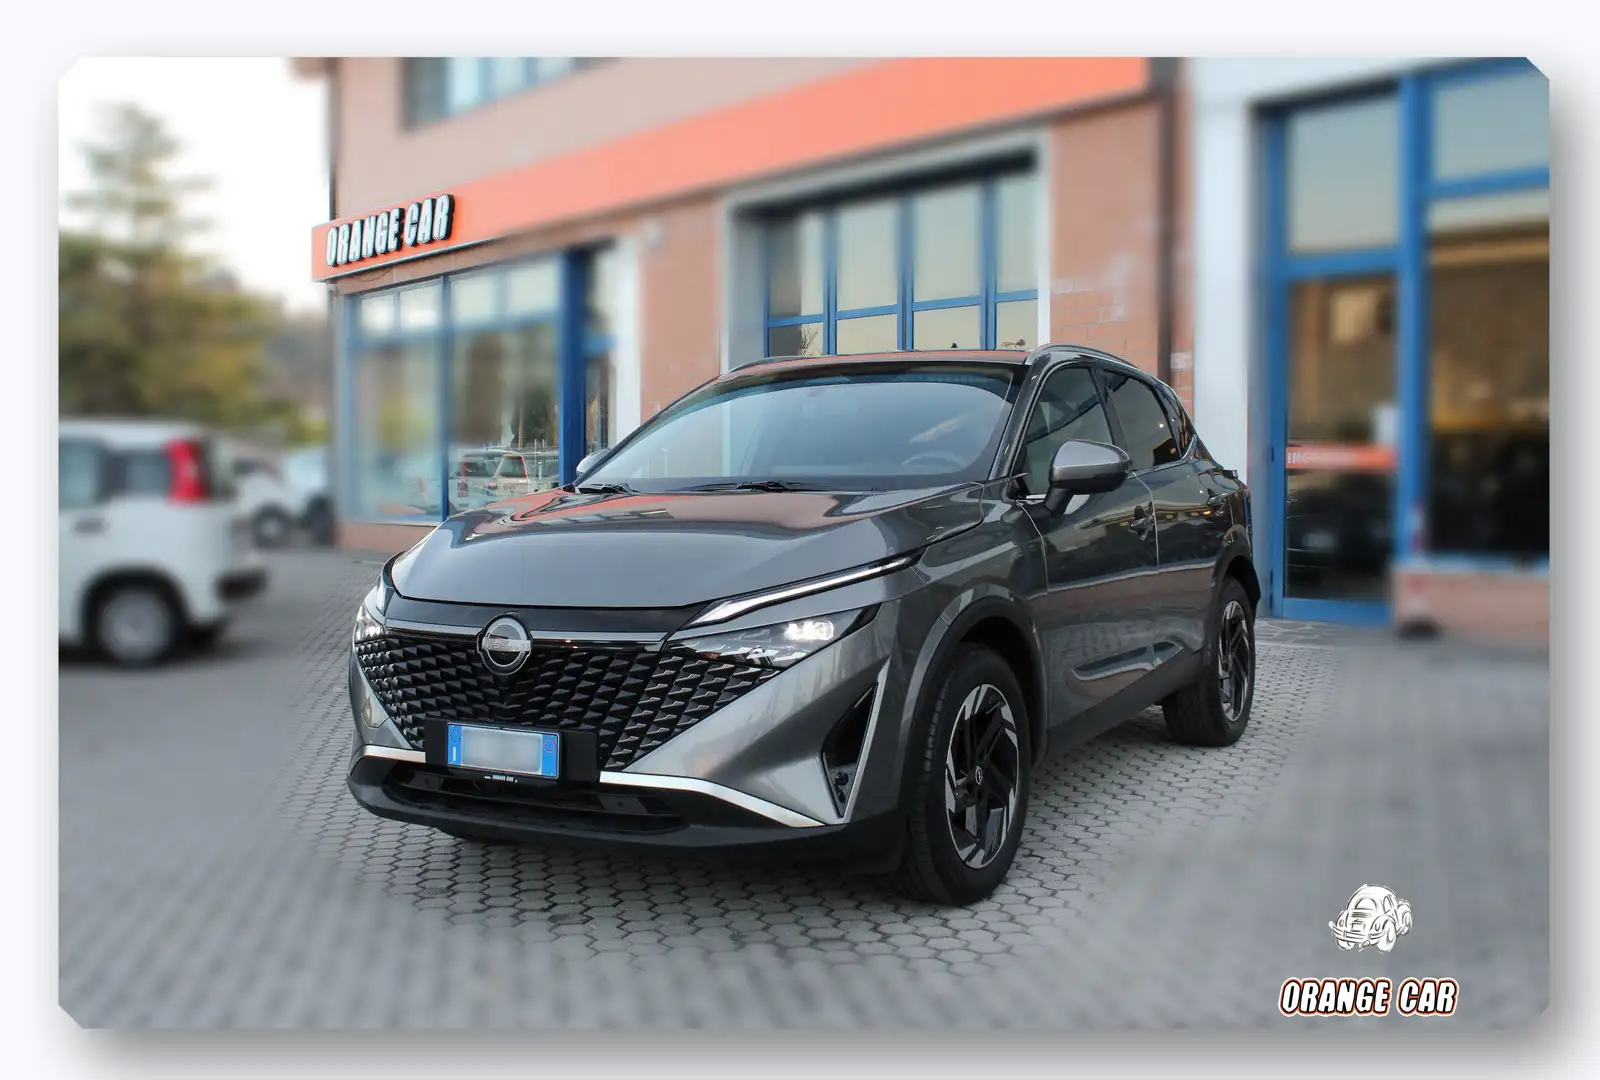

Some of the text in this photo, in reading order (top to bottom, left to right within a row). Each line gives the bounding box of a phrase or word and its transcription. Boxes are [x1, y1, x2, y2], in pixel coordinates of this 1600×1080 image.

[326, 194, 454, 267] ORANGE CAR
[483, 638, 530, 652] NISSN
